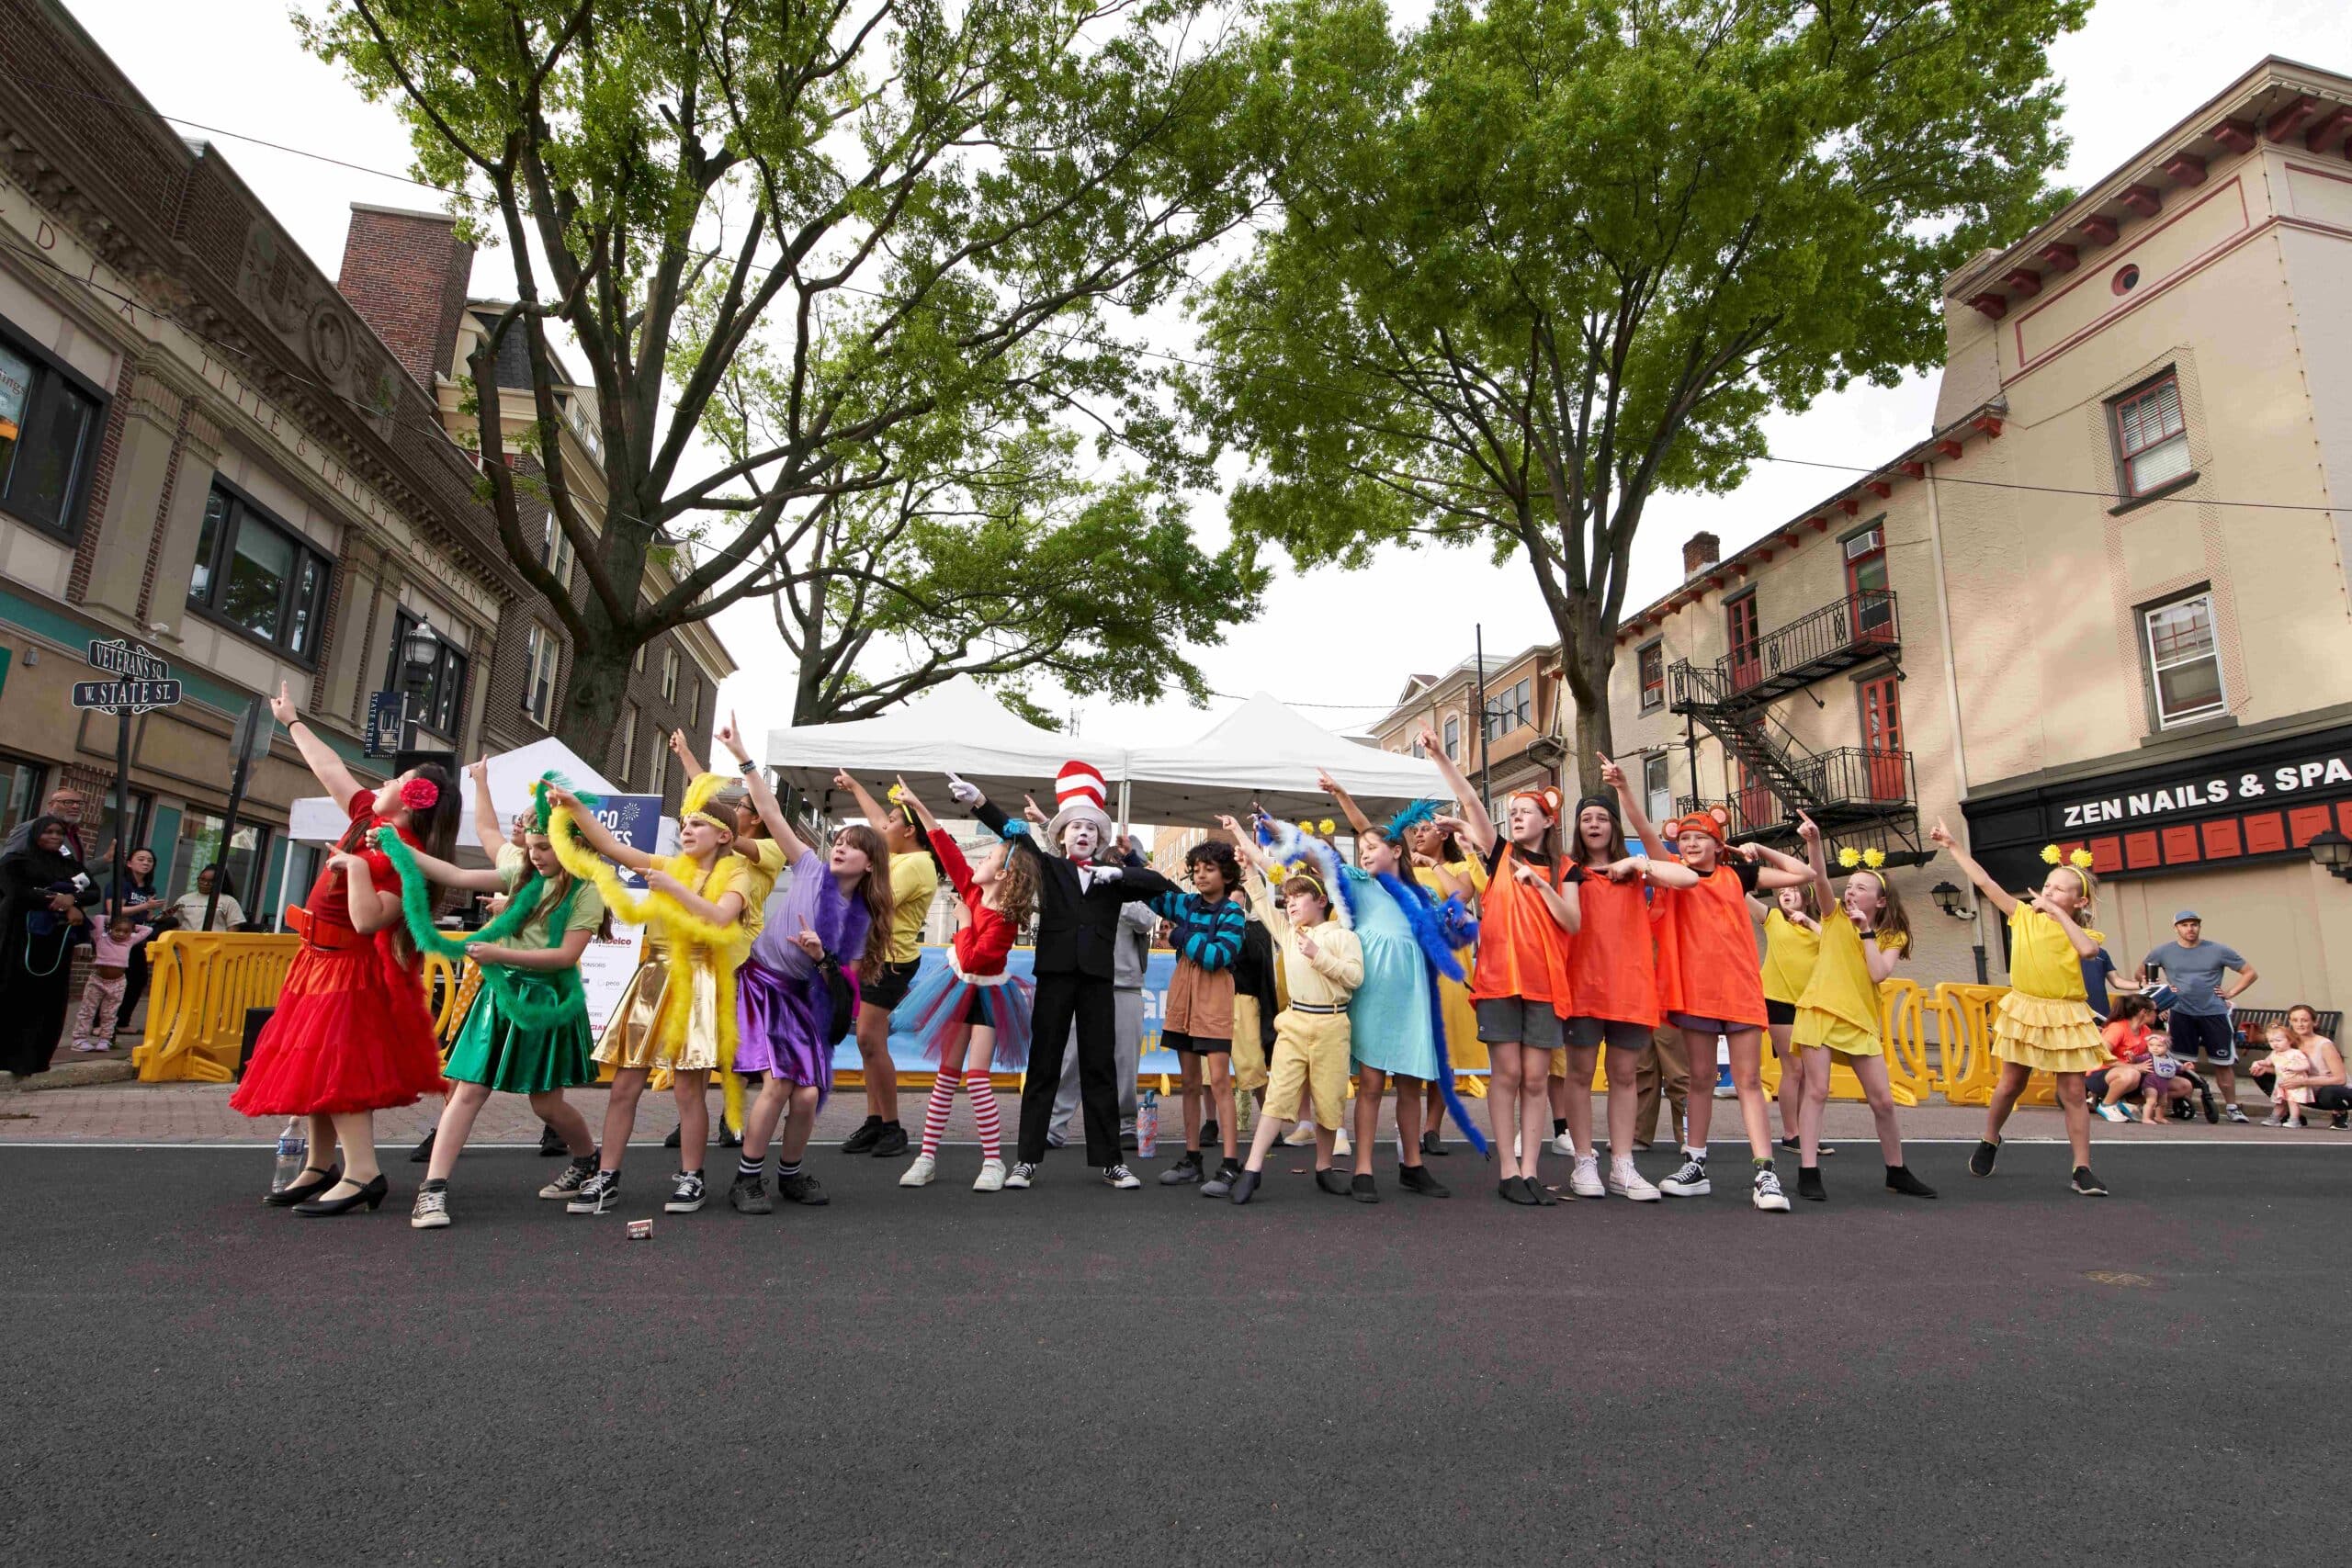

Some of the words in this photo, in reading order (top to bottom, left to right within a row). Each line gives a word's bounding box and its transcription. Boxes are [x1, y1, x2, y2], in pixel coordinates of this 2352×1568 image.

[201, 351, 282, 437] TITLE
[296, 435, 306, 457] &
[322, 455, 393, 526] TRUST
[410, 538, 487, 610] COMPANY
[96, 644, 149, 679] VETERANS
[152, 663, 164, 680] SQ.
[85, 686, 94, 702] W.
[100, 683, 149, 704] STATE
[155, 684, 171, 700] ST.
[369, 694, 379, 718] STATE
[365, 722, 375, 754] STREET
[2064, 799, 2123, 827] ZEN
[2129, 780, 2230, 817] NAILS
[2239, 773, 2266, 797] &
[2275, 758, 2352, 791] SPA
